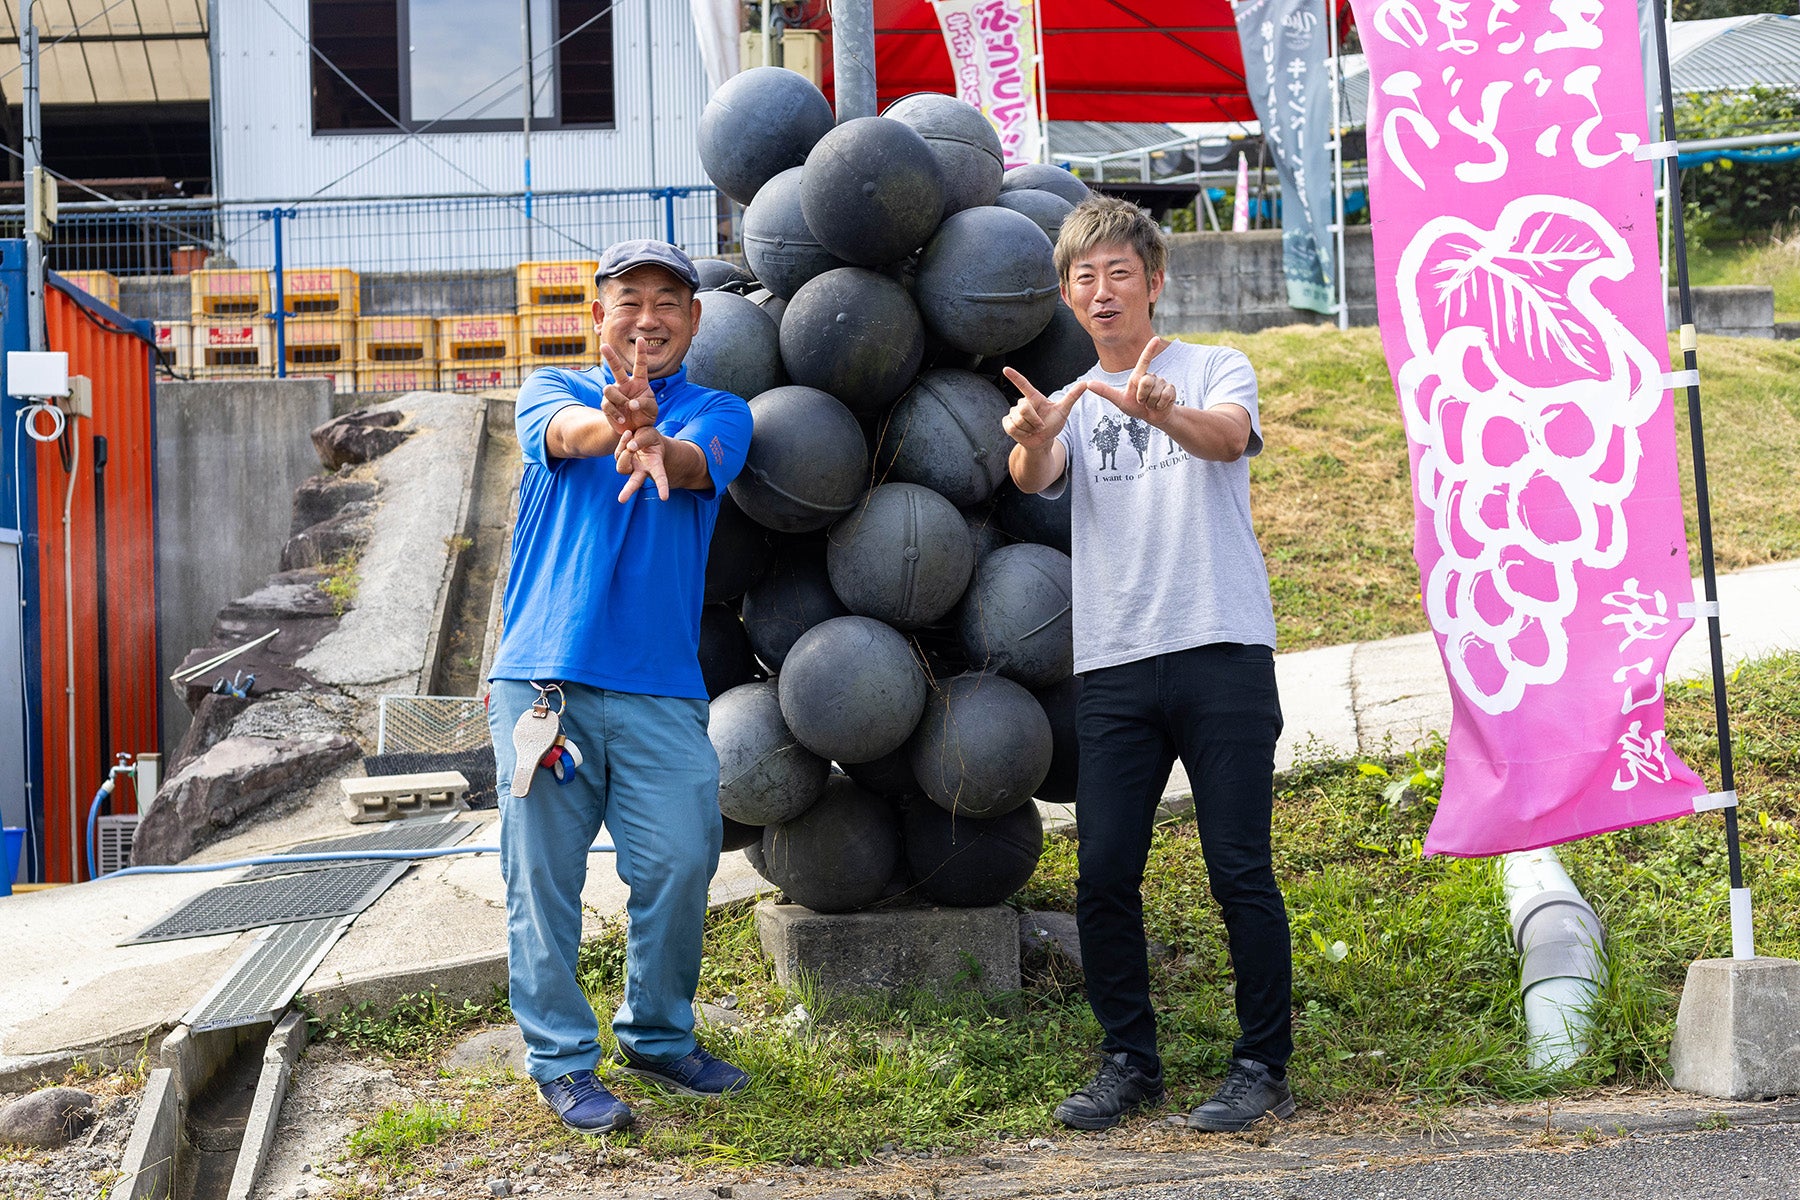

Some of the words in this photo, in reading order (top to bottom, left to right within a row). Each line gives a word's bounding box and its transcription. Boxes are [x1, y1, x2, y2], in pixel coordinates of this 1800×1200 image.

[537, 270, 578, 284] KIRIN
[457, 325, 498, 338] KIRIN
[537, 321, 579, 334] KIRIN
[1095, 475, 1099, 483] I
